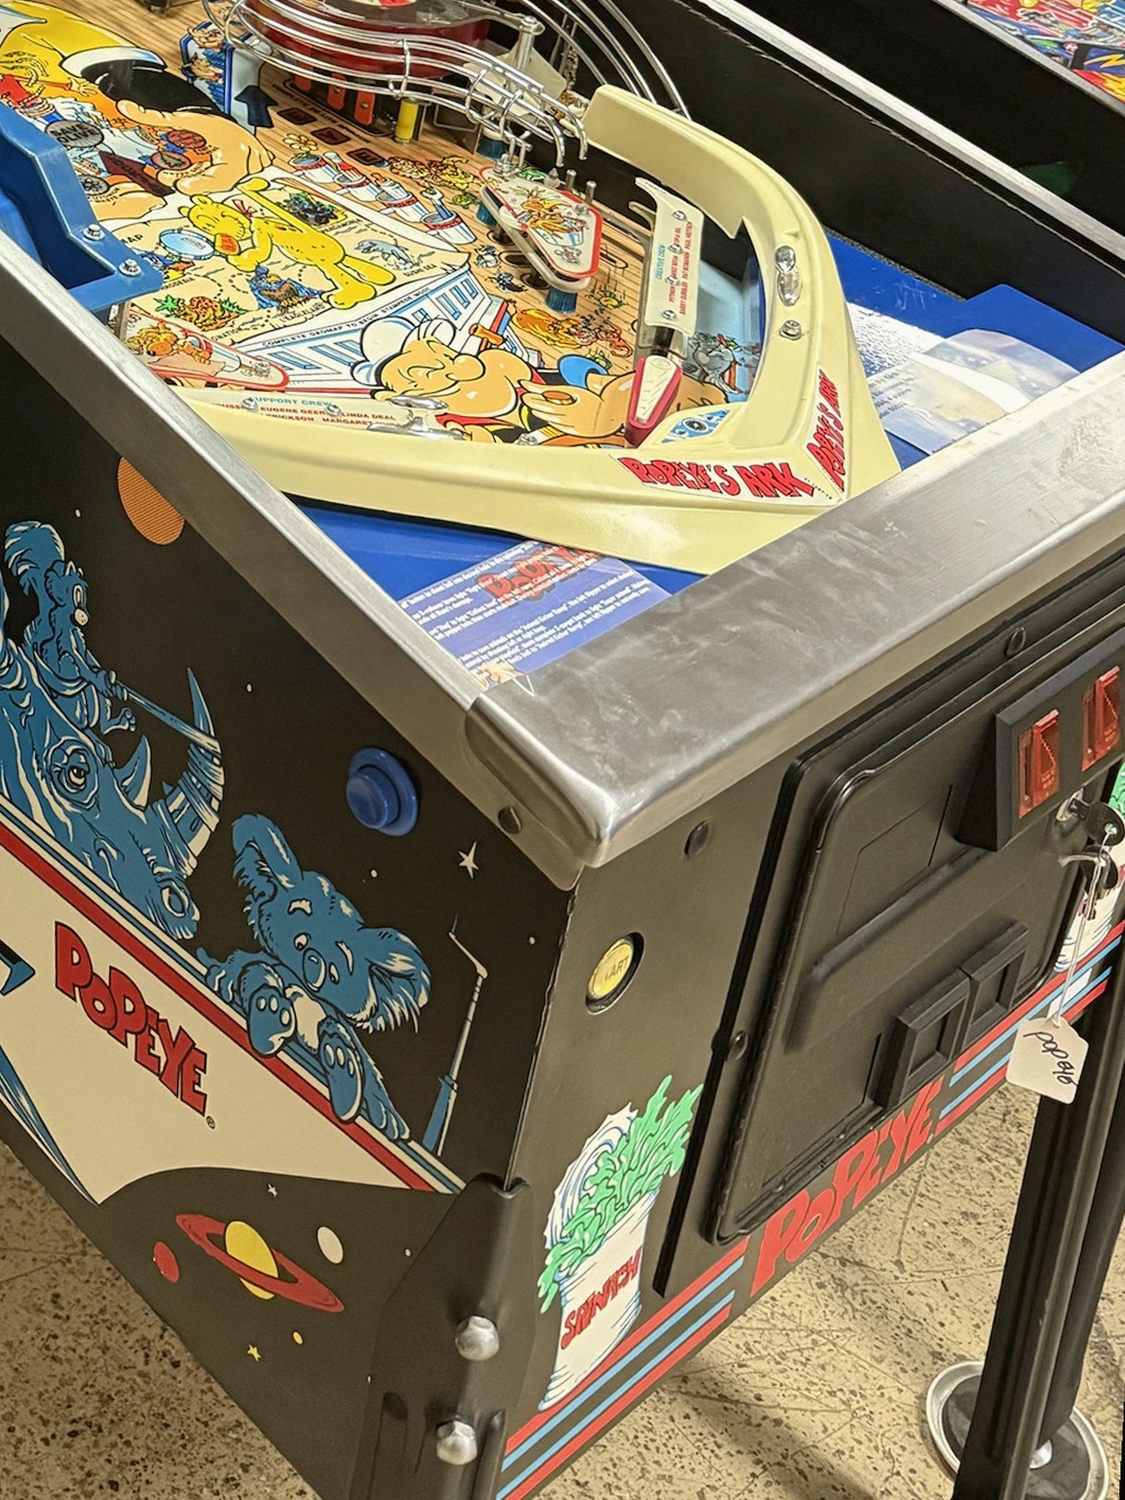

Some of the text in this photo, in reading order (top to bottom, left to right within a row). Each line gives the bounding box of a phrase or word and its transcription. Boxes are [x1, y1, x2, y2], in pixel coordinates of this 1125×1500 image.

[57, 128, 100, 143] OLIVE
[261, 333, 307, 347] COMPLETE
[346, 321, 358, 329] TO
[260, 406, 299, 414] EUGENE
[817, 368, 843, 418] ARK
[617, 456, 741, 496] POPEYE'S
[732, 461, 815, 498] ARK
[604, 954, 631, 982] ART
[55, 920, 208, 1117] POPEYE
[750, 1075, 944, 1298] POPEYE
[561, 1247, 641, 1350] SPINACH
